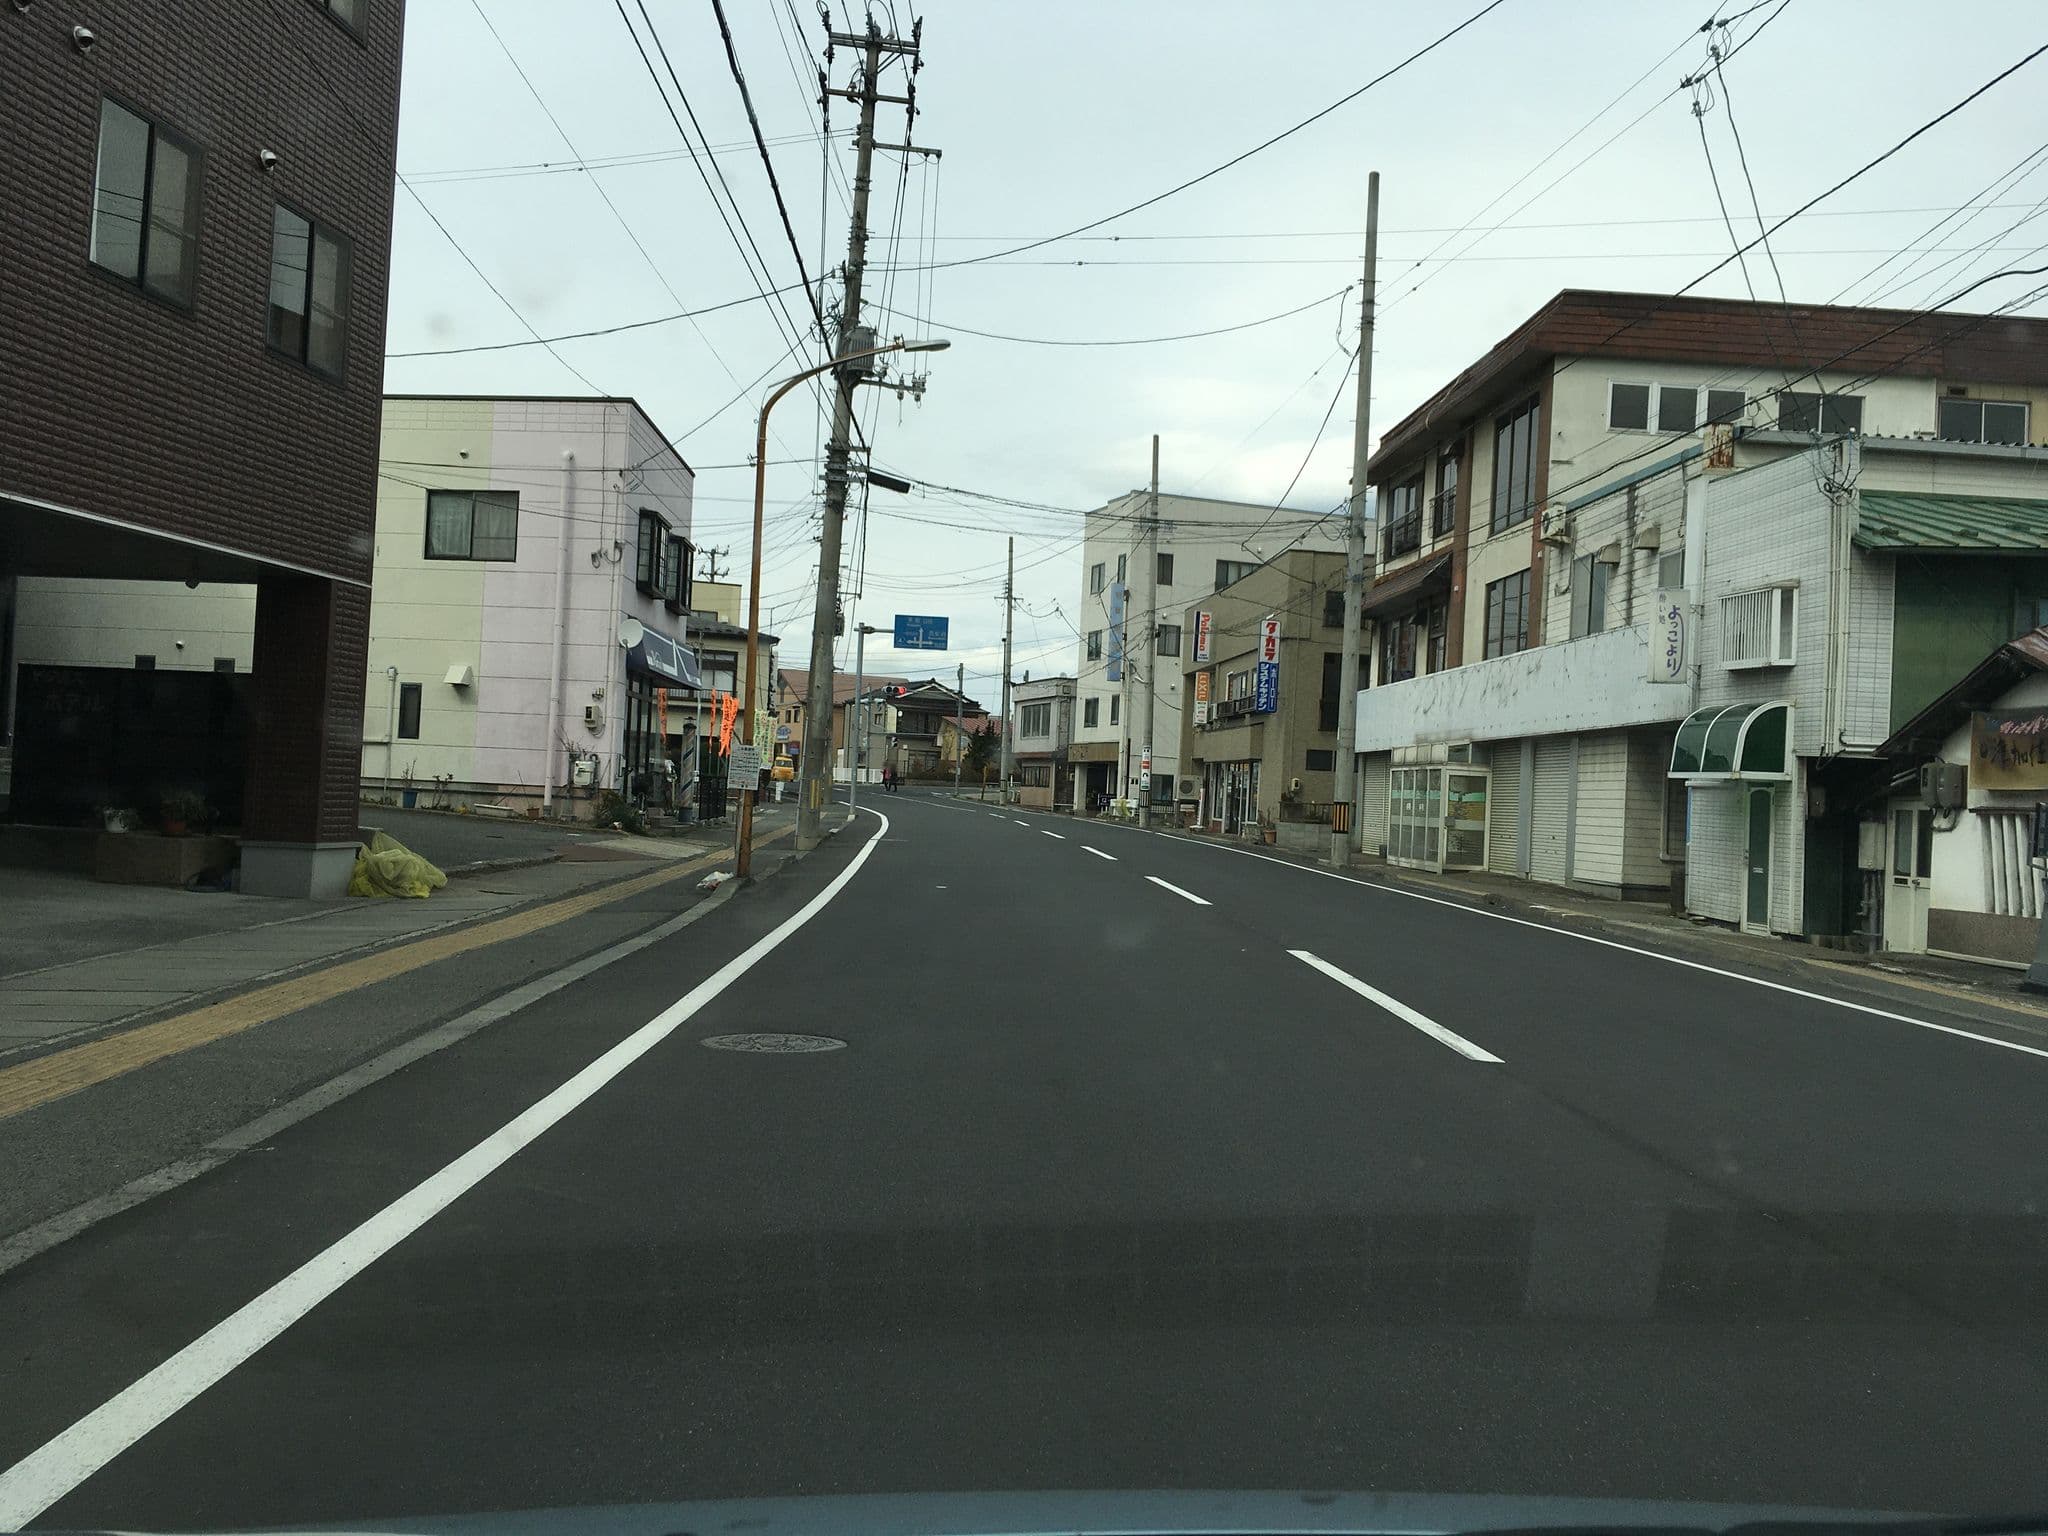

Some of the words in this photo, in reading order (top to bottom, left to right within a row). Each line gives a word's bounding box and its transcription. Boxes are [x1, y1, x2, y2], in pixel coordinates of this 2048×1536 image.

[1200, 614, 1211, 651] Paloma
[1264, 622, 1278, 661] タカラ
[1666, 604, 1684, 677] よっこより
[1199, 675, 1208, 699] LIXIL
